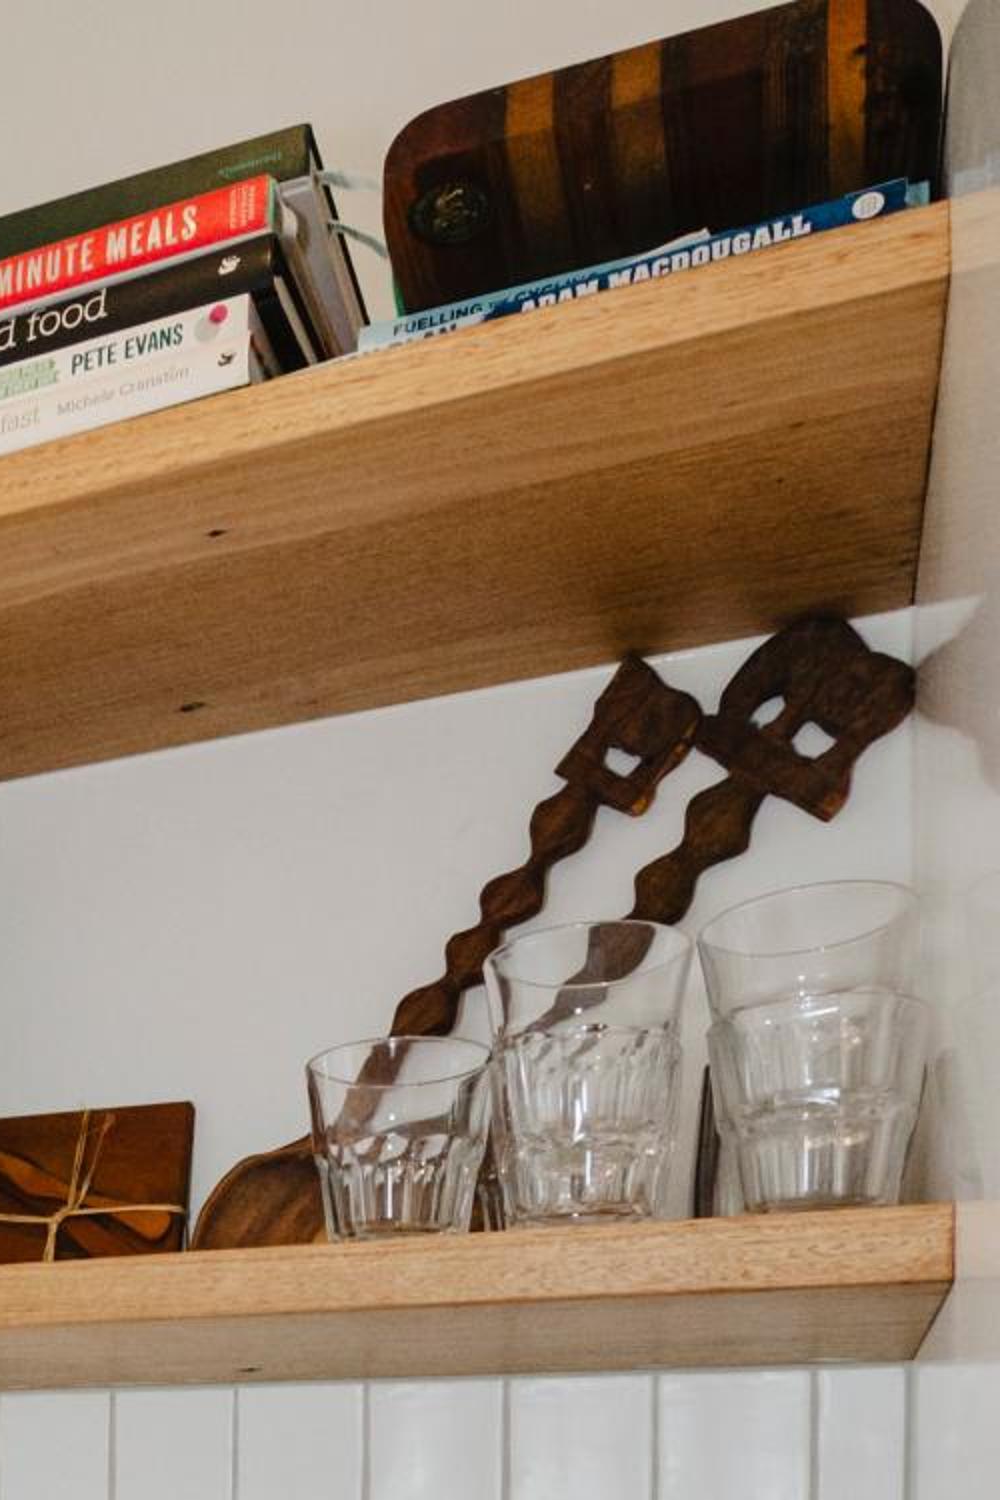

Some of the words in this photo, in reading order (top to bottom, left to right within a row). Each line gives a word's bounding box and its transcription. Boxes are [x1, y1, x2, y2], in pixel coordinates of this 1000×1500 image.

[105, 204, 198, 263] MEALS
[27, 288, 108, 342] food
[393, 303, 483, 337] FUELLING
[71, 342, 117, 375] PETE
[125, 323, 183, 359] EVANS
